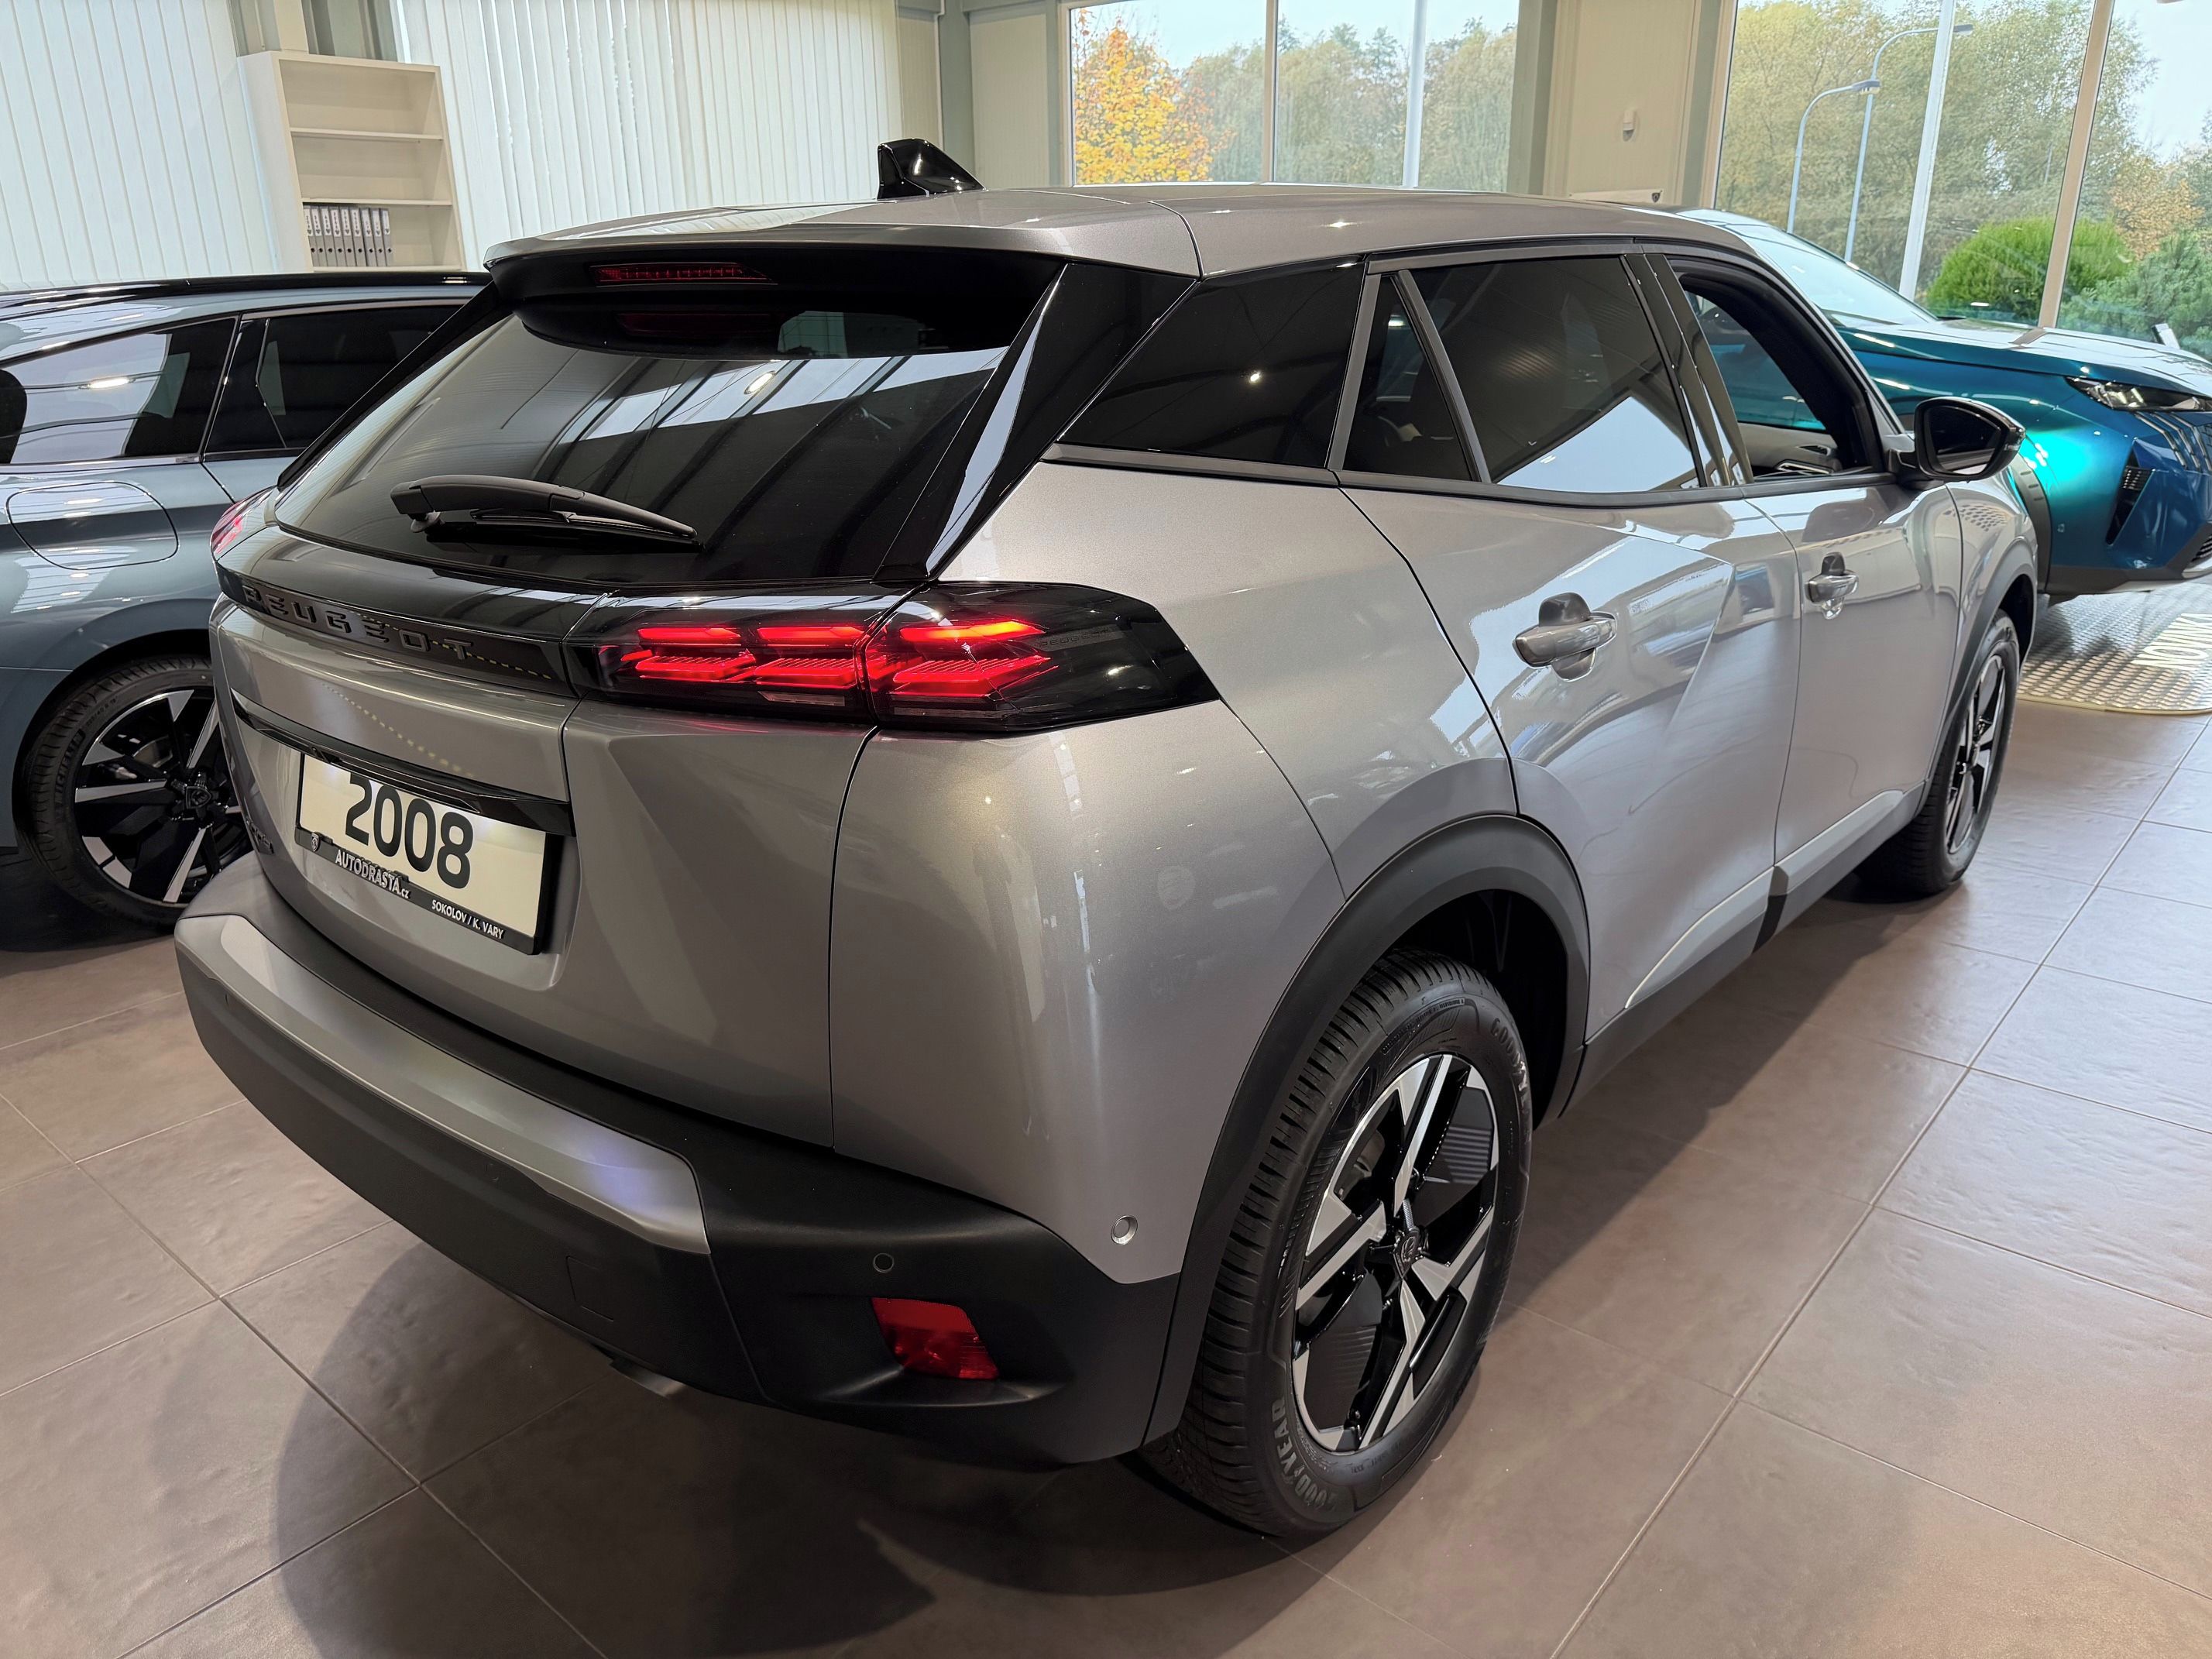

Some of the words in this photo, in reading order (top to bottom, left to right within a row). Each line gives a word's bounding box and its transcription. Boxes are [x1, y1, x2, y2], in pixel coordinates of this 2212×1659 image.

[242, 585, 473, 659] PEUGEOT
[345, 773, 474, 889] 2008
[335, 850, 410, 899] AUTODRASTA.cz
[431, 899, 467, 923] SOKOLOV
[472, 919, 481, 930] K.
[482, 922, 504, 939] VARY
